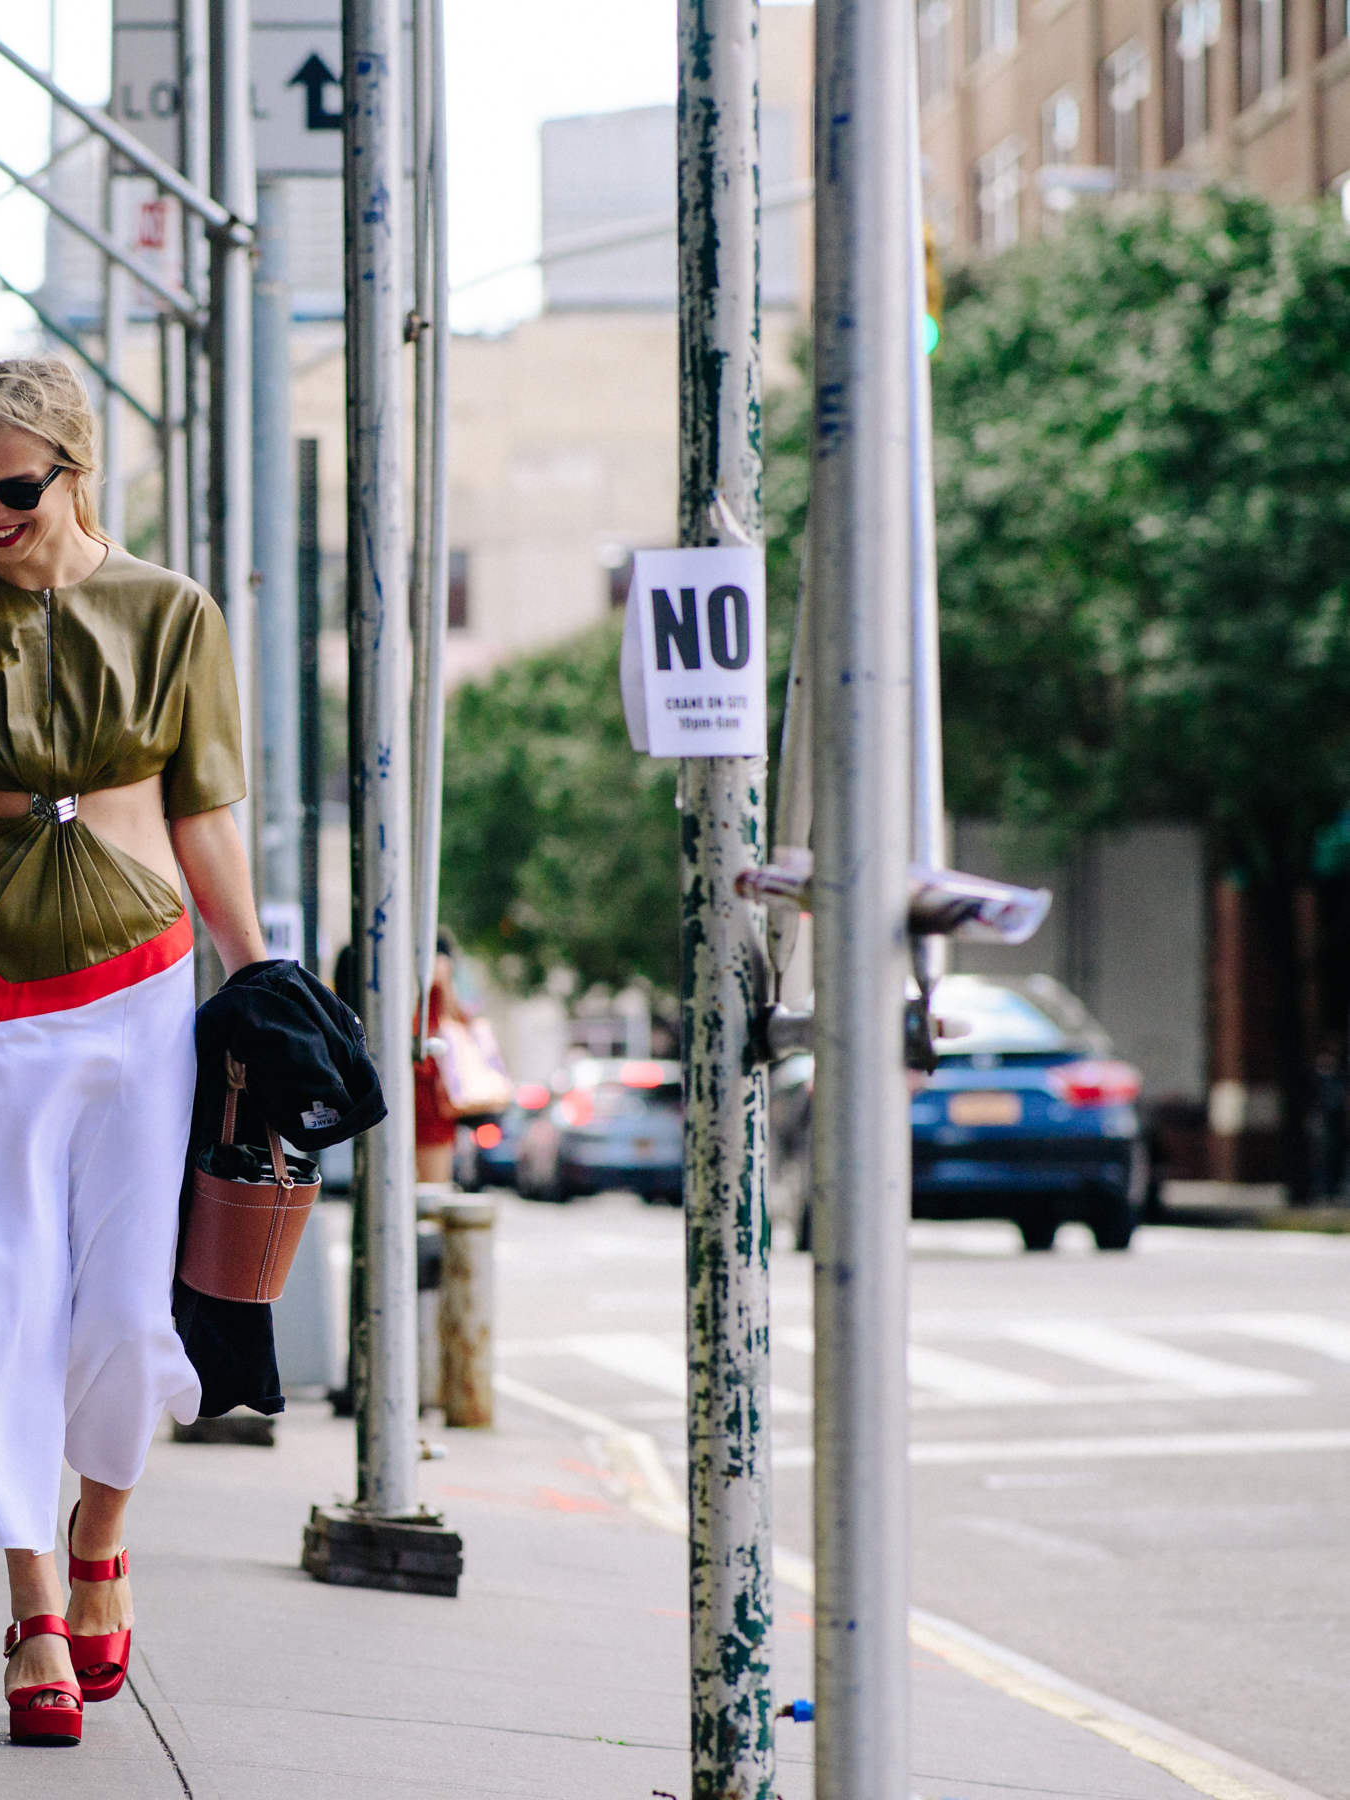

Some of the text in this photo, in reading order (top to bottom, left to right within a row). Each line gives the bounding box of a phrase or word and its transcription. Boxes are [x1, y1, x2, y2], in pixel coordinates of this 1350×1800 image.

[122, 83, 271, 121] LOL
[651, 584, 750, 671] NO
[311, 1116, 338, 1128] FRAME
